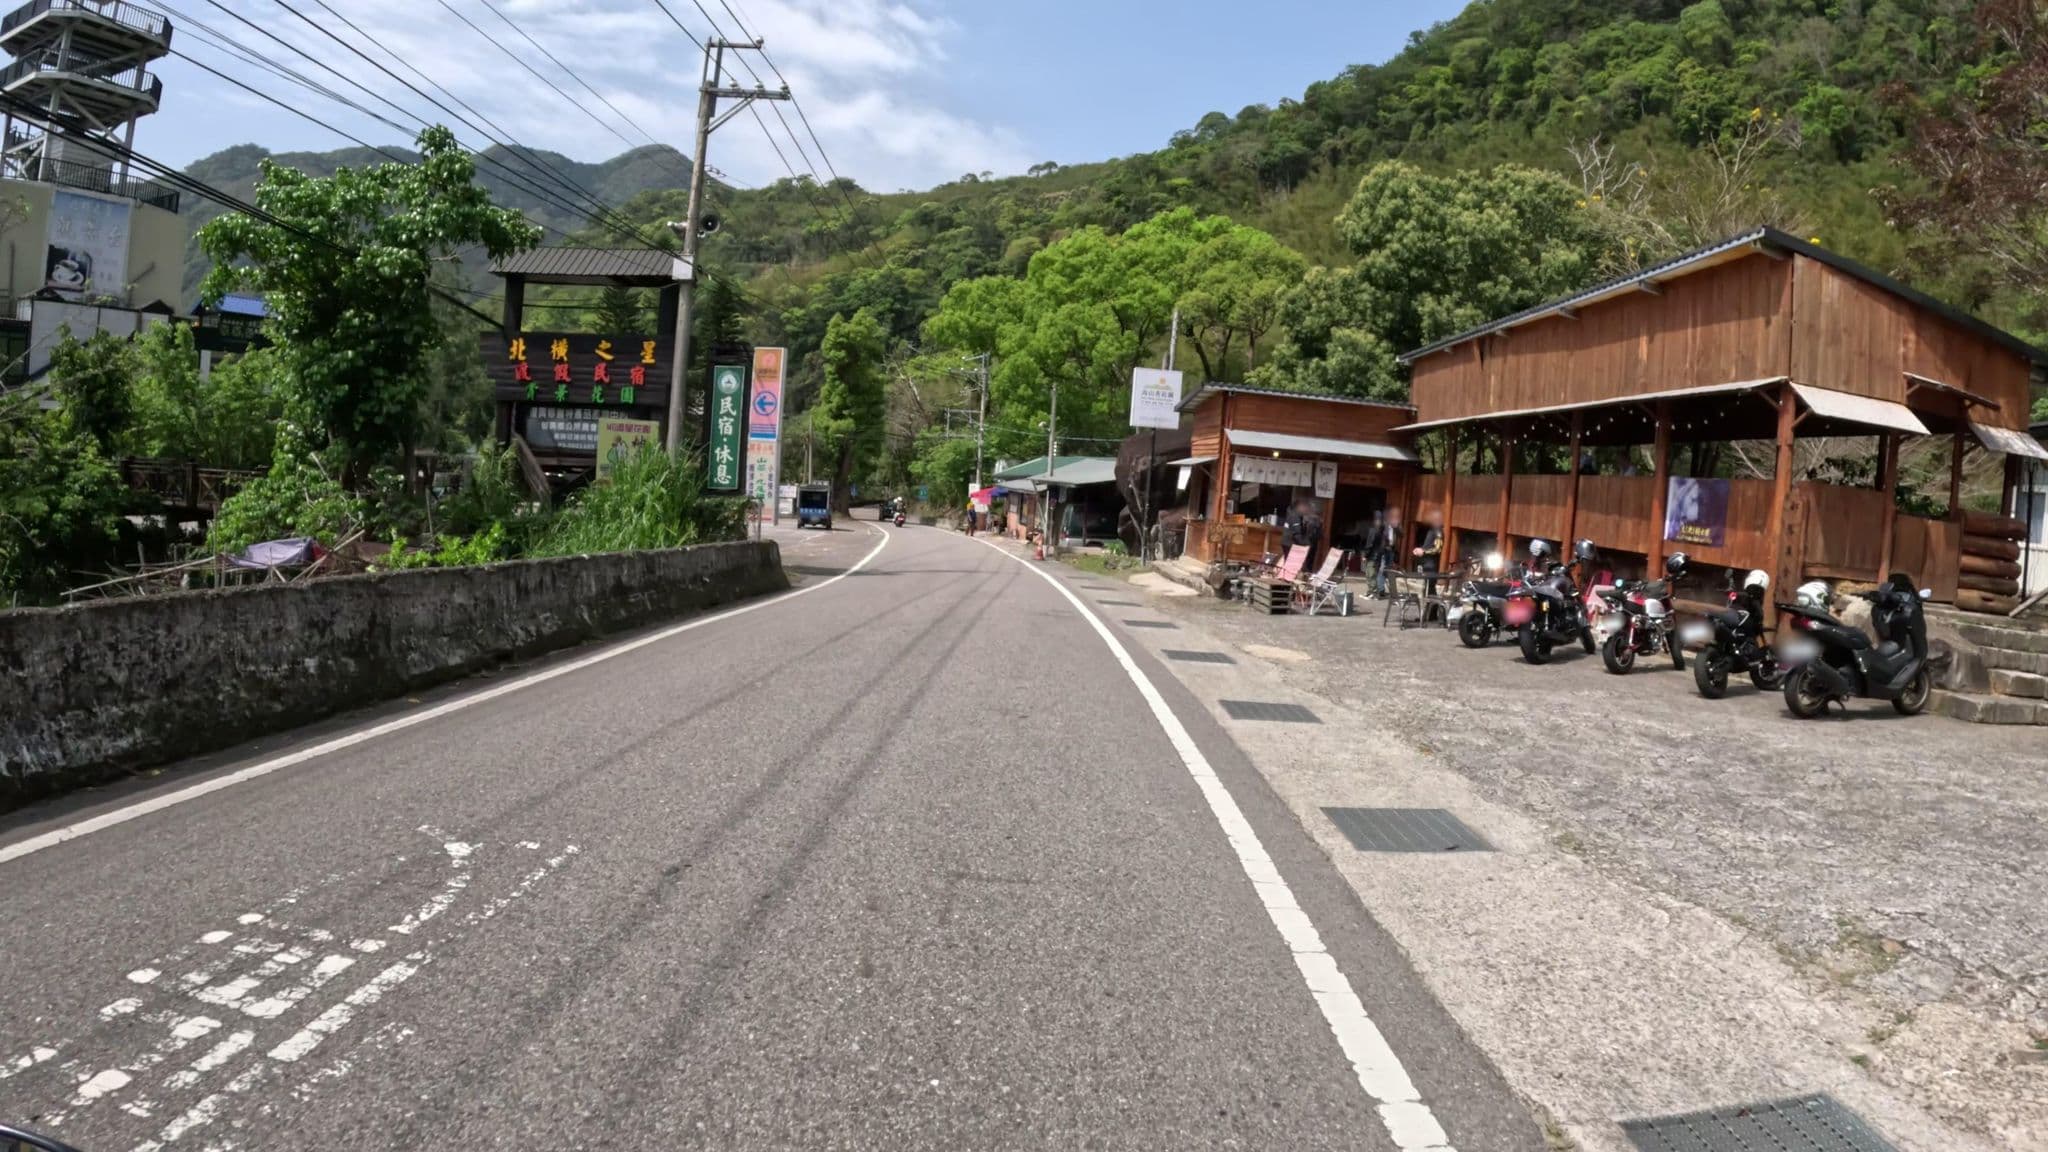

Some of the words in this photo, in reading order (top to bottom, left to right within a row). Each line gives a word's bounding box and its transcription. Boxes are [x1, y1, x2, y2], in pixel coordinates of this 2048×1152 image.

[509, 337, 656, 364] 北橫之星
[515, 362, 645, 385] 渡假民宿
